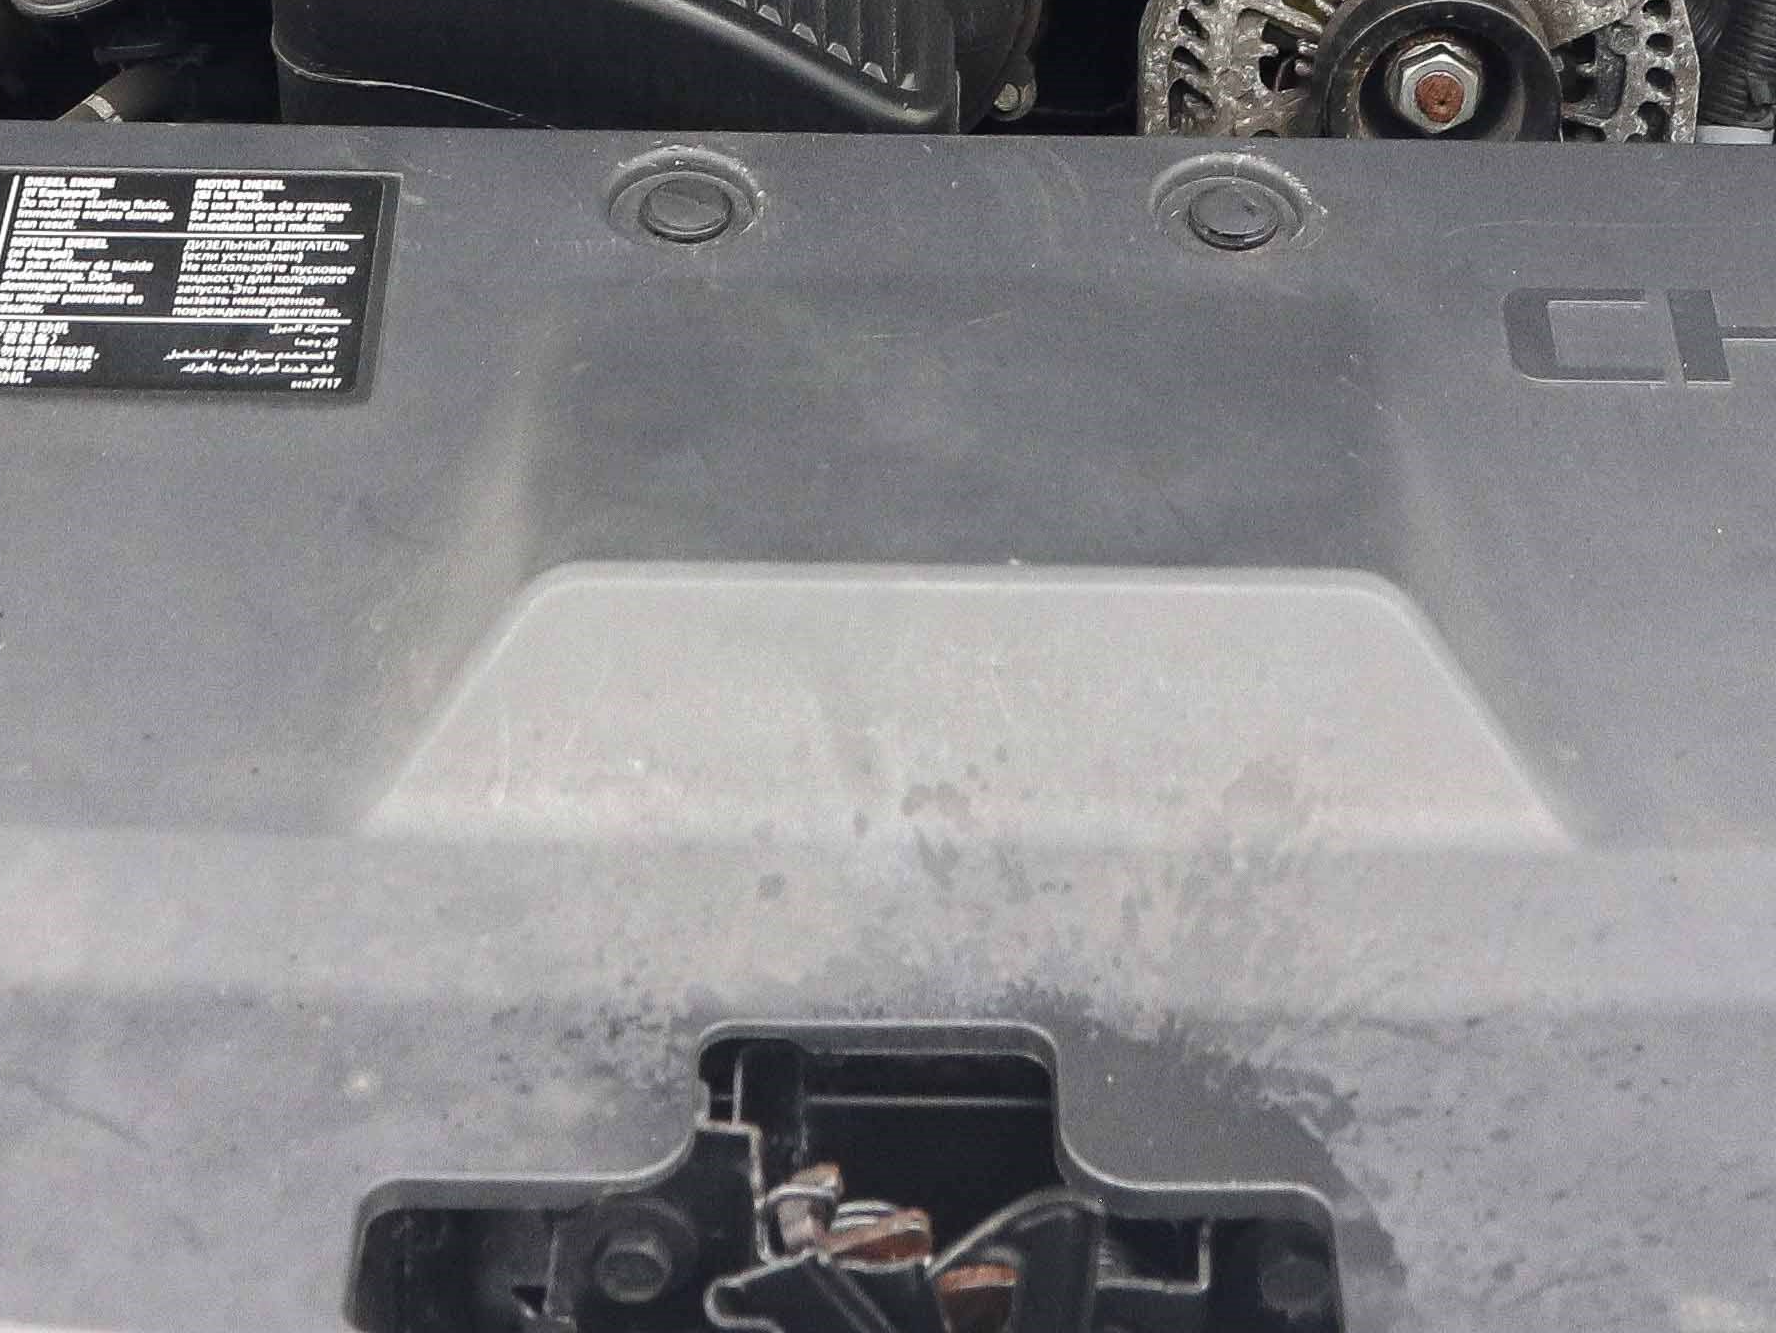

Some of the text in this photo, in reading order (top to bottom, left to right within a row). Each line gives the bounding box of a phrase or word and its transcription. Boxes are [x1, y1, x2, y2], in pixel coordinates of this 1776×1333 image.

[25, 176, 116, 189] DIESEL ENGINE
[195, 179, 286, 191] MOTOR DIESEL
[19, 198, 36, 208] Do
[38, 199, 59, 209] not
[61, 200, 83, 209] use
[85, 199, 131, 211] starting
[191, 200, 208, 211] No
[211, 202, 233, 211] use
[235, 200, 276, 211] fluidos
[278, 201, 294, 211] de
[82, 209, 123, 221] engine
[125, 210, 174, 223] damage
[189, 211, 206, 221] Se
[208, 211, 253, 223] pueden
[255, 211, 305, 223] producir
[14, 220, 37, 229] can
[255, 223, 272, 232] en
[274, 221, 286, 232] el
[10, 236, 109, 249] MOTEUR DIESEL
[183, 239, 350, 252] ДИЗЕЛЬНЫЙ ДВИГАТЕЛЬ
[182, 251, 304, 264] (если установлен)
[5, 259, 154, 273] Ne pas utiliser de liquide
[179, 262, 356, 276] Не используйте пусковые
[88, 271, 113, 282] Des
[177, 274, 347, 286] жидкости для холодного
[0, 281, 68, 293] dommages
[258, 285, 304, 295] может
[15, 293, 61, 303] moteur
[60, 293, 125, 305] pourraient
[126, 294, 144, 304] en
[173, 295, 325, 308] вызвать немедленное
[171, 306, 267, 318] повреждение
